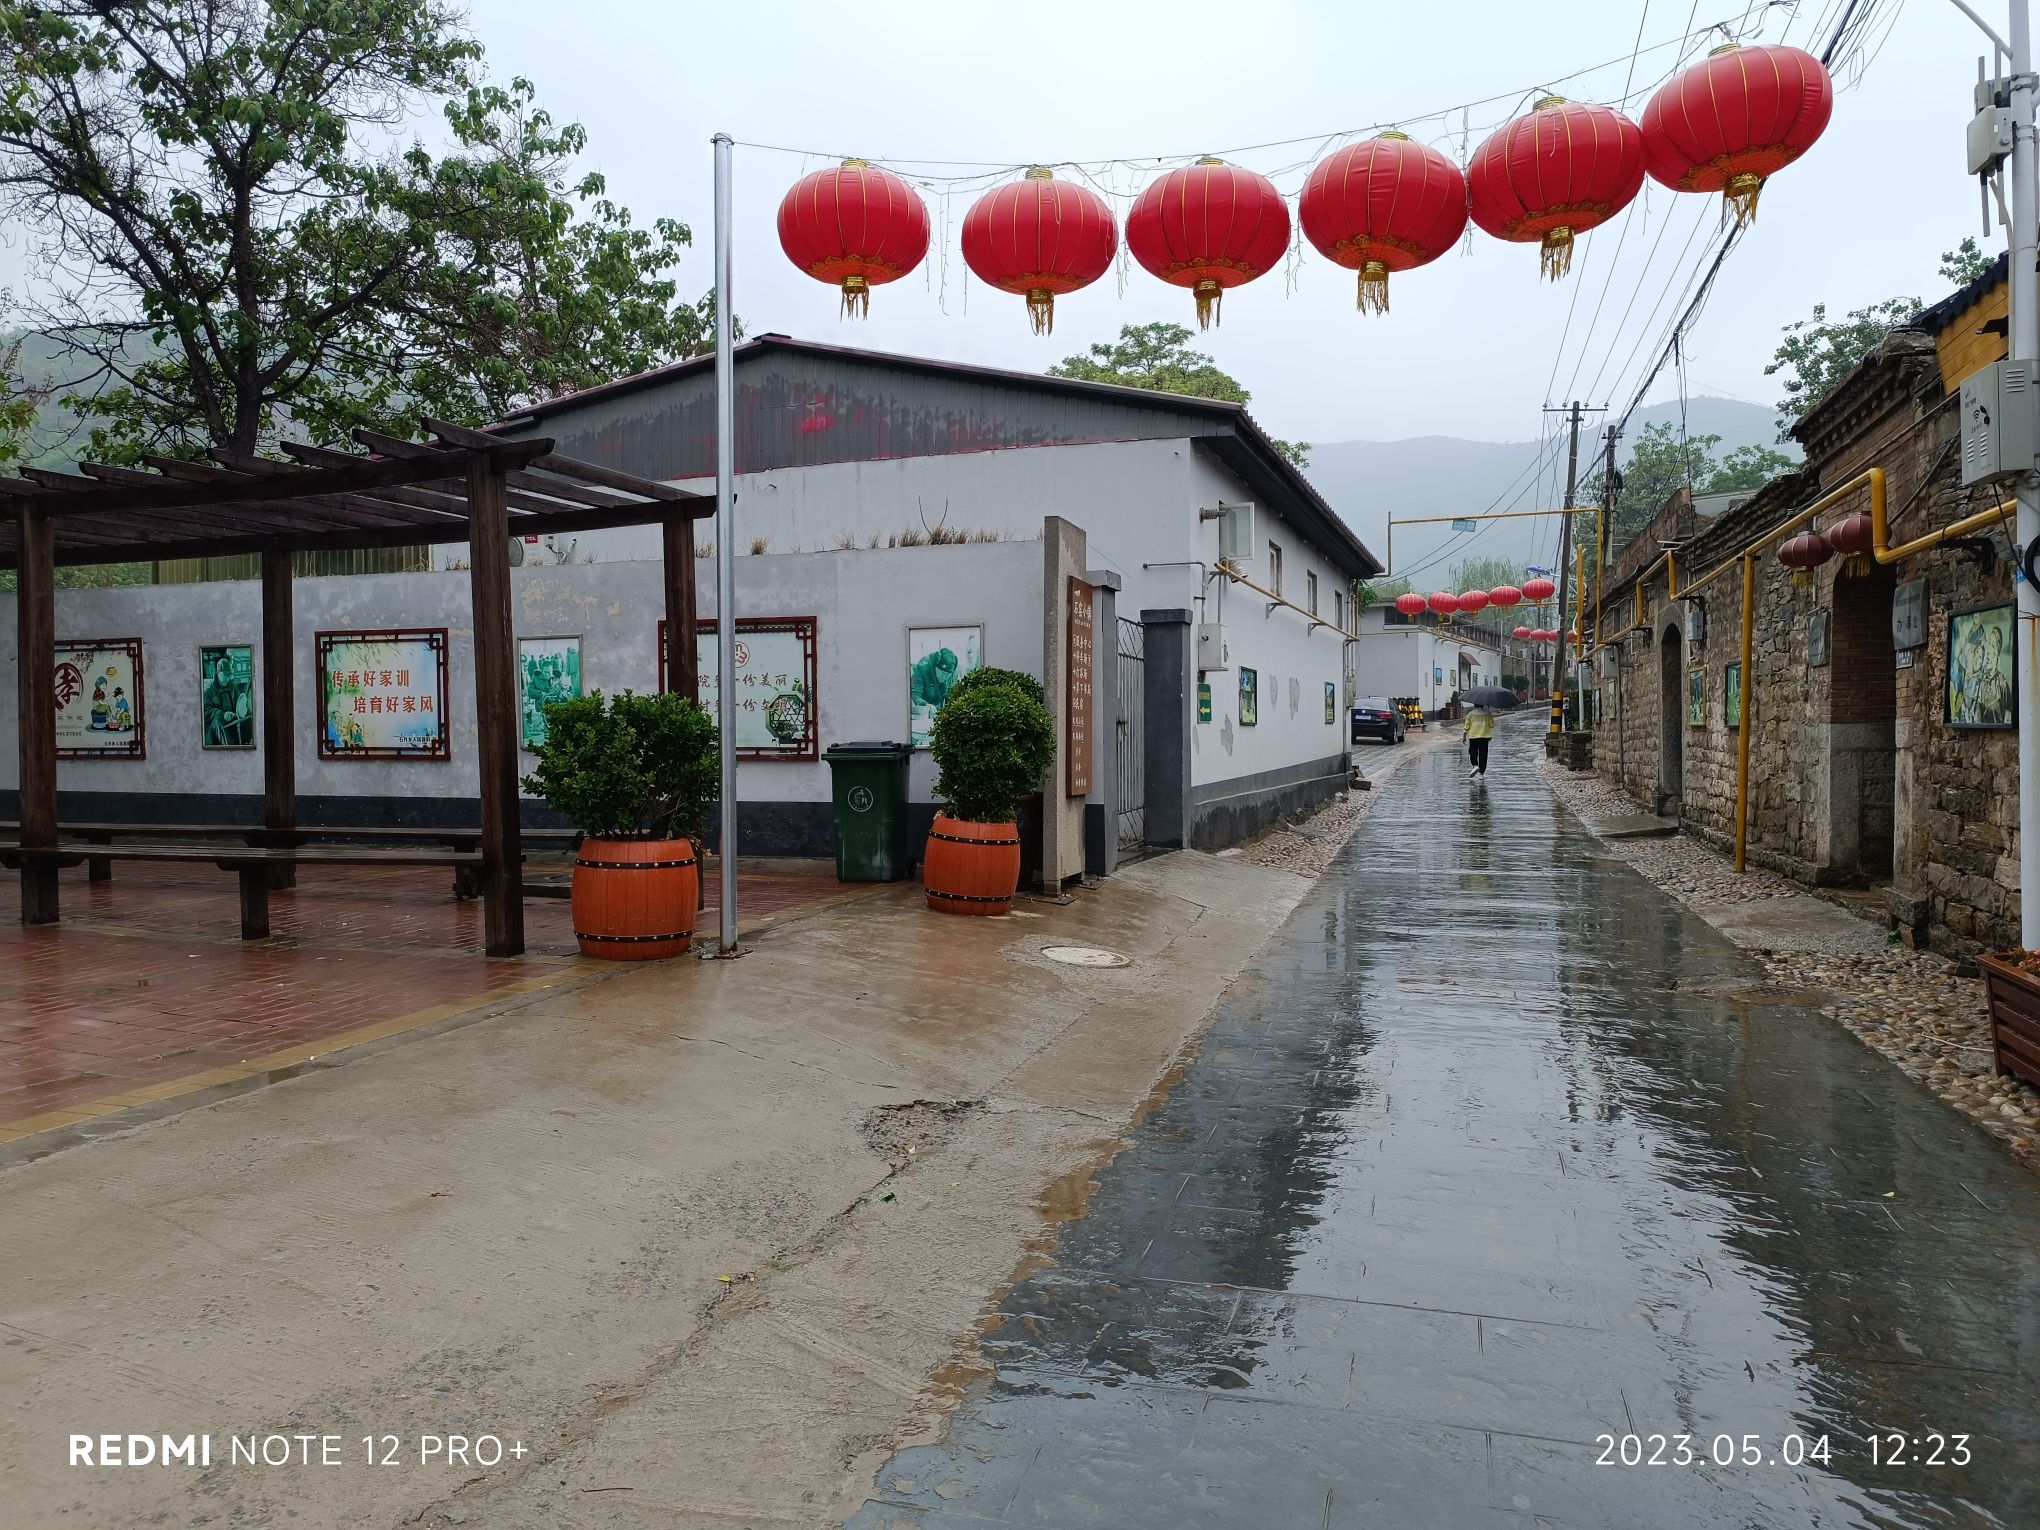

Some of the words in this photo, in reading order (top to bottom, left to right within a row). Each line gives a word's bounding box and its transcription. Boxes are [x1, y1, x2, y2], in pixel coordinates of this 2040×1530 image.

[332, 669, 410, 688] 传承好家训
[698, 672, 788, 688] 院份美丽
[354, 695, 434, 714] 培育好家风
[700, 698, 788, 713] 村份文明
